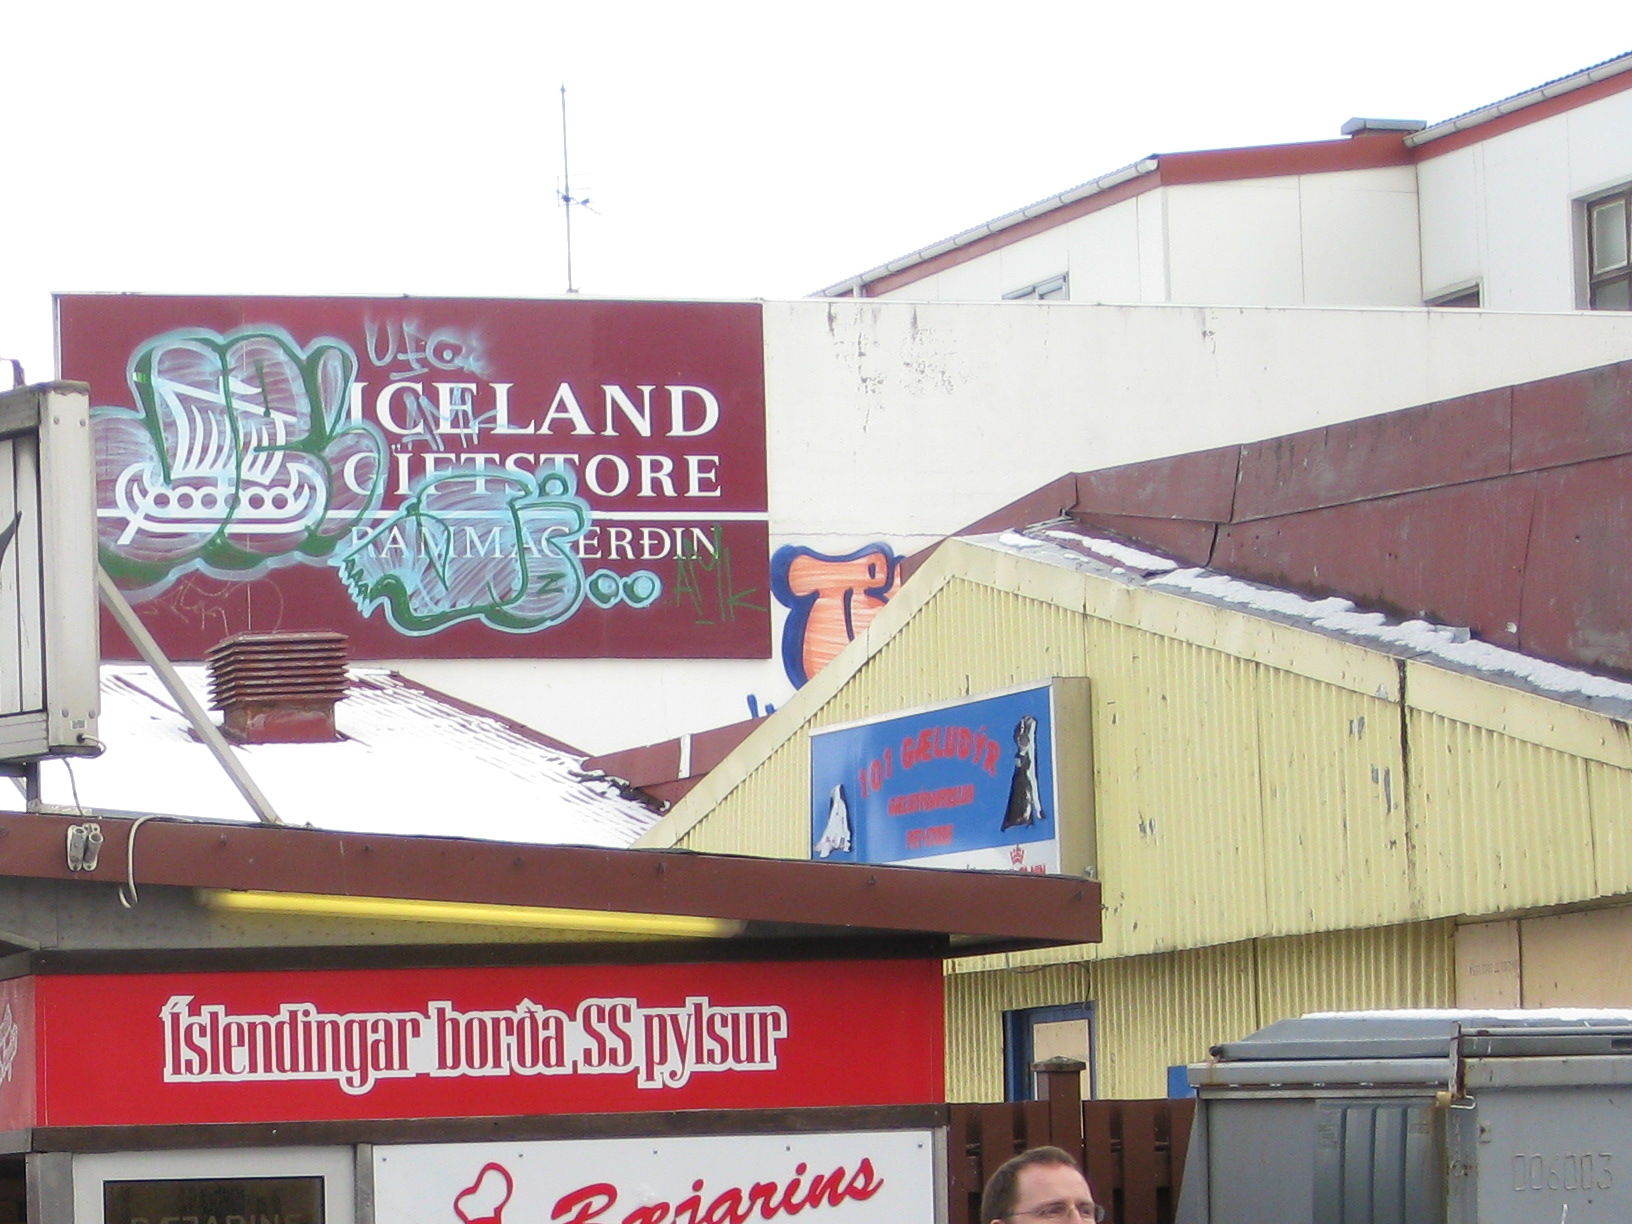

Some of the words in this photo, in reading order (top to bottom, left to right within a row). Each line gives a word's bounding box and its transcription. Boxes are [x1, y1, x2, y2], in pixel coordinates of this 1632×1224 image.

[348, 381, 719, 437] ICELAND
[858, 746, 893, 799] 101
[162, 996, 422, 1092] Íslendingar
[433, 998, 568, 1073] borða
[581, 1001, 633, 1069] SS
[643, 1000, 786, 1084] pylsur
